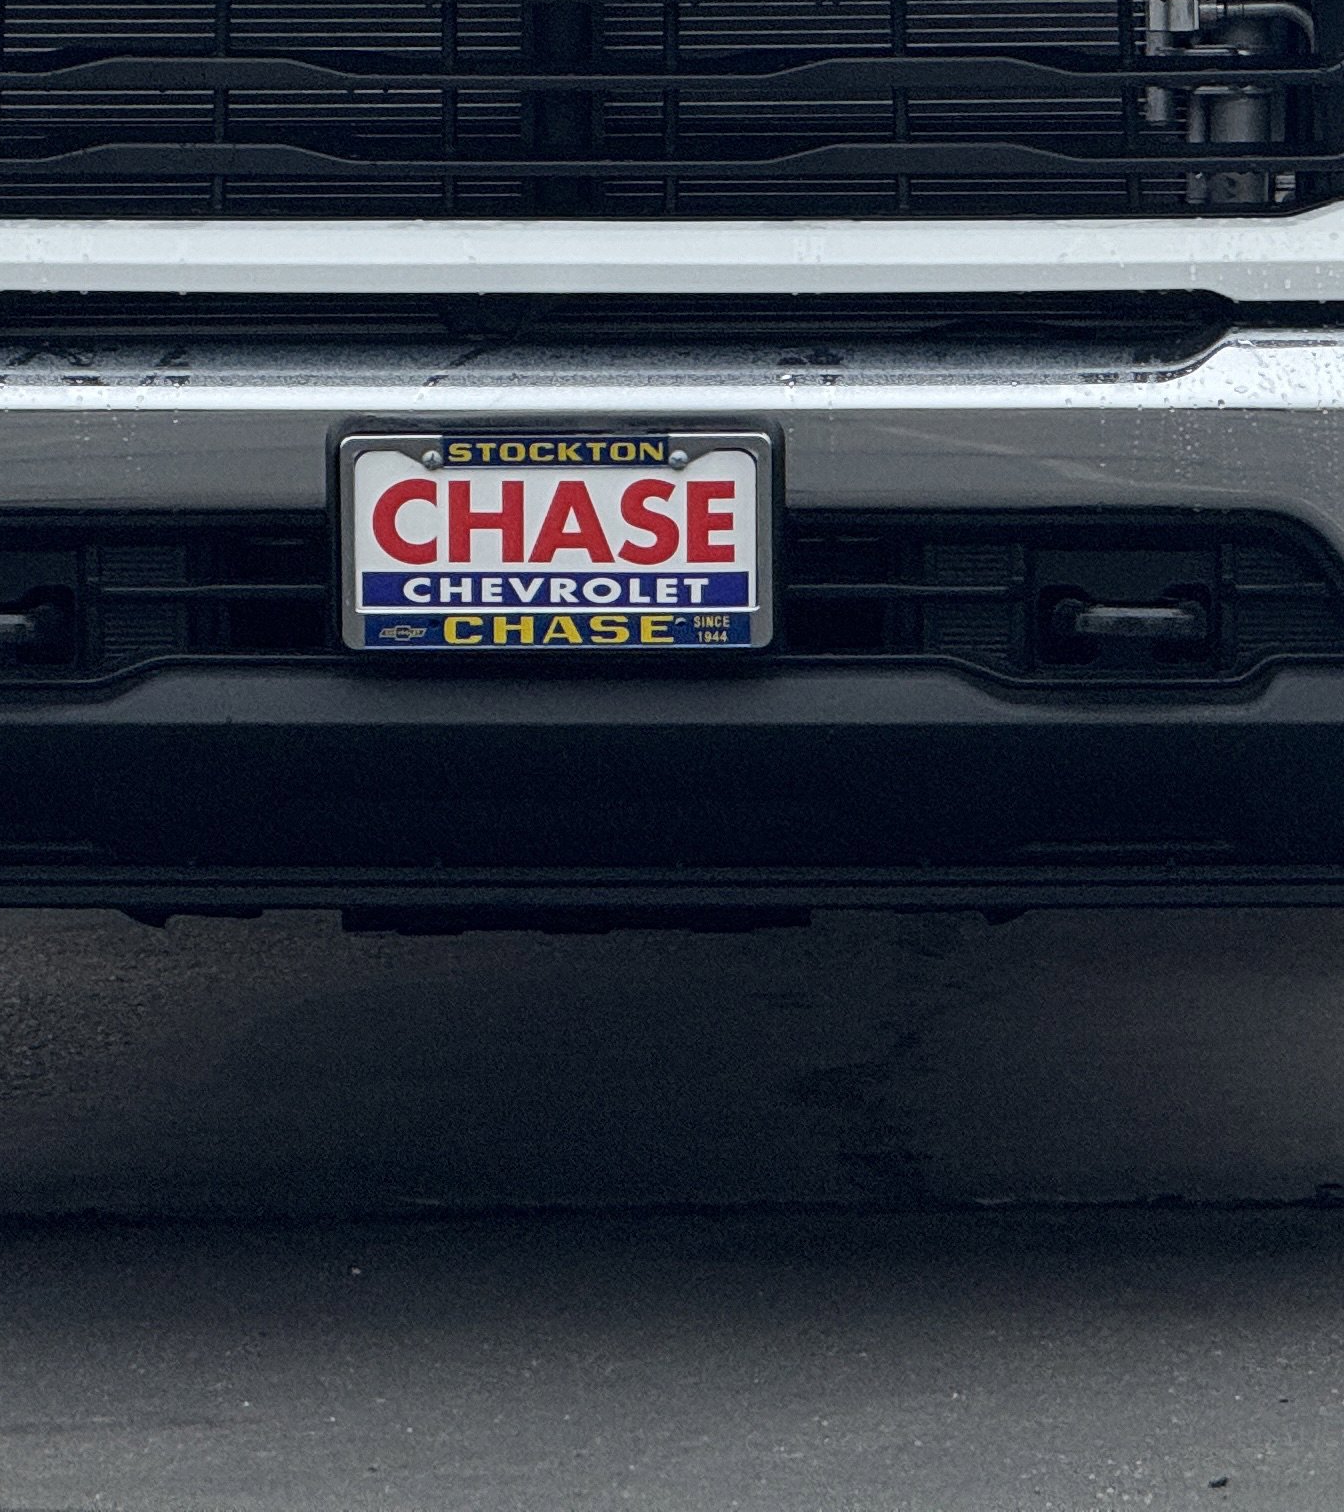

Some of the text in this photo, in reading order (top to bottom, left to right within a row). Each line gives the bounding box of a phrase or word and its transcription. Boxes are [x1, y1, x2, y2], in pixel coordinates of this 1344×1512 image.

[448, 442, 664, 463] STOCKTON
[372, 478, 736, 566] CHASE
[403, 578, 709, 604] CHEVROLET
[443, 615, 676, 645] CHASE
[693, 615, 730, 628] SINCE
[697, 630, 728, 643] 1944
